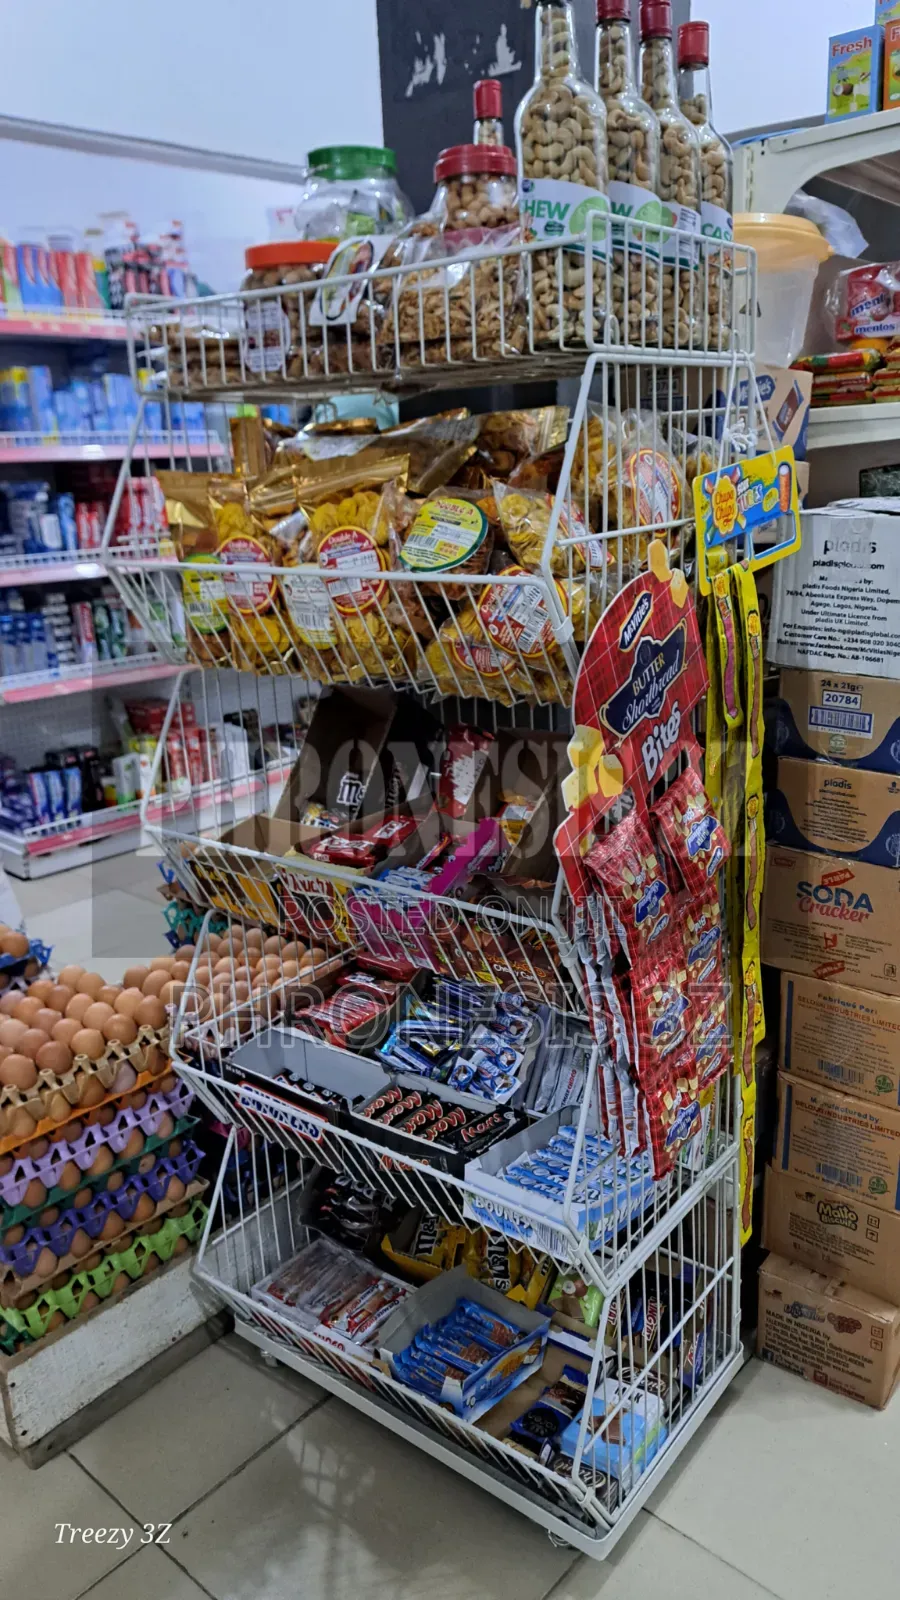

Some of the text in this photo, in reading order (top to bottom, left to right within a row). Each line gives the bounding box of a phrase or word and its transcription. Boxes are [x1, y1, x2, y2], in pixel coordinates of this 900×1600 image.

[832, 37, 872, 57] Fresh
[855, 323, 895, 335] mentos
[841, 585, 864, 594] Nigeria
[836, 594, 860, 602] Express
[820, 610, 847, 618] Ultimate
[848, 612, 871, 620] Licence
[784, 631, 812, 639] Customer
[813, 633, 828, 641] Care
[797, 649, 822, 657] NAFDAC
[631, 652, 666, 697] BUTTER
[820, 679, 832, 688] 24
[622, 649, 680, 732] Shortbread
[824, 693, 859, 706] 20784
[642, 701, 682, 781] Bites
[824, 778, 852, 790] pladis
[796, 881, 874, 914] SODA
[798, 896, 870, 923] Cracker
[869, 1112, 880, 1124] by
[460, 1112, 503, 1143] Mars
[818, 1200, 858, 1221] Malto
[765, 1308, 784, 1322] MADE
[785, 1316, 793, 1324] IN
[793, 1319, 822, 1338] NIGERIA
